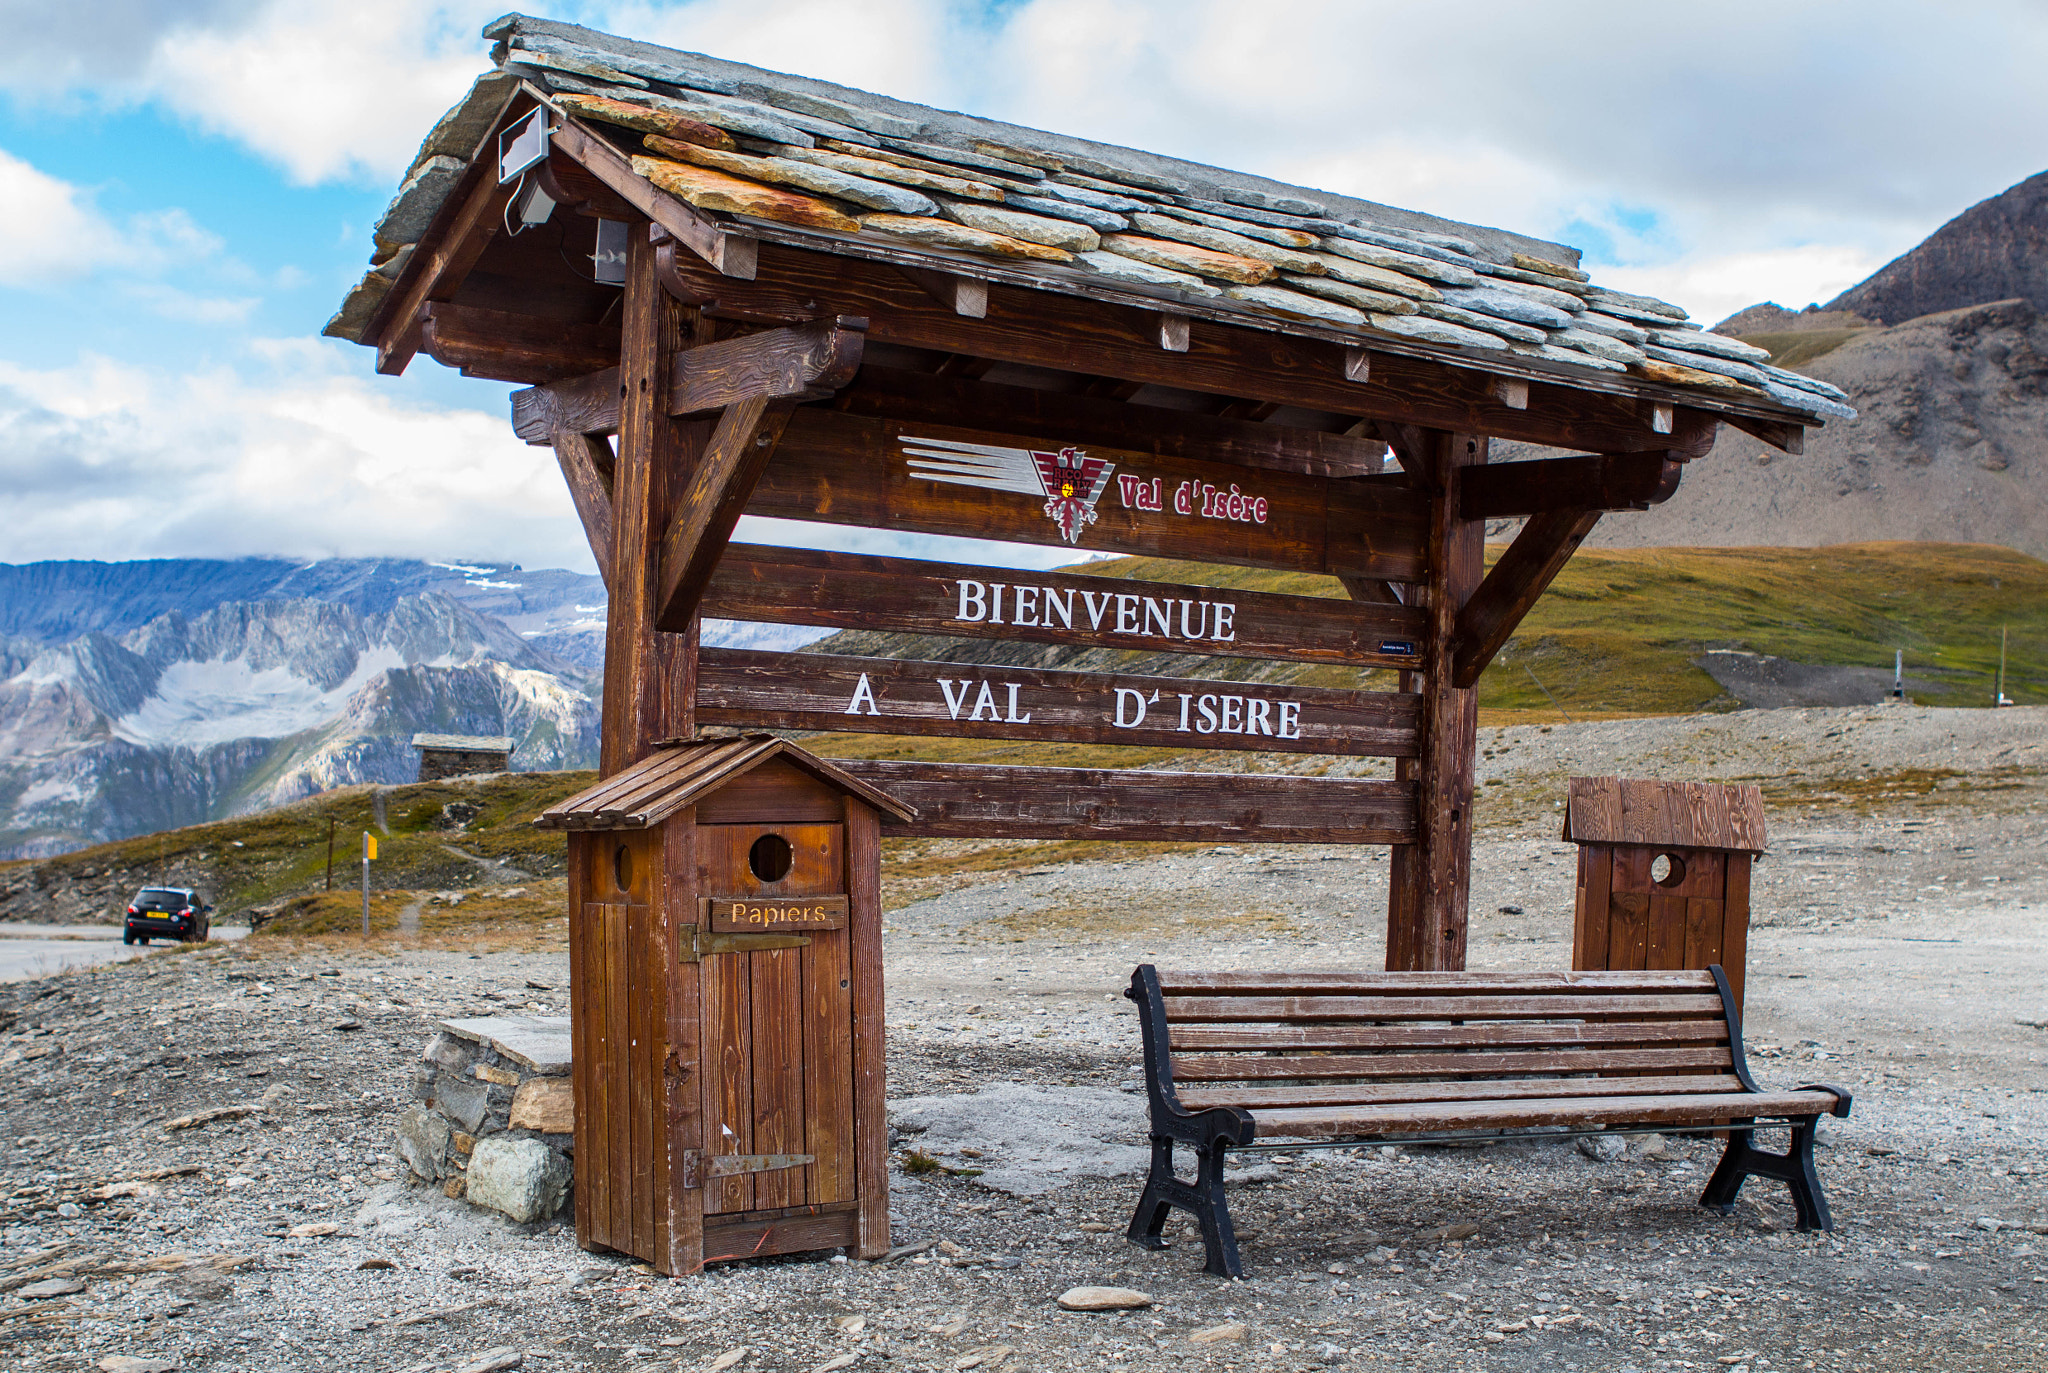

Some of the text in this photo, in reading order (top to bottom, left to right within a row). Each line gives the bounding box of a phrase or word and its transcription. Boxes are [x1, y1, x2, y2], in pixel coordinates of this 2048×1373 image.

[1052, 478, 1090, 491] RALLY
[1053, 466, 1083, 480] RICO
[1117, 474, 1268, 523] Val d'Isère
[955, 579, 1236, 642] BIENVENUE
[844, 672, 882, 716] A
[936, 679, 1031, 724] VAL
[731, 902, 827, 928] Papiers
